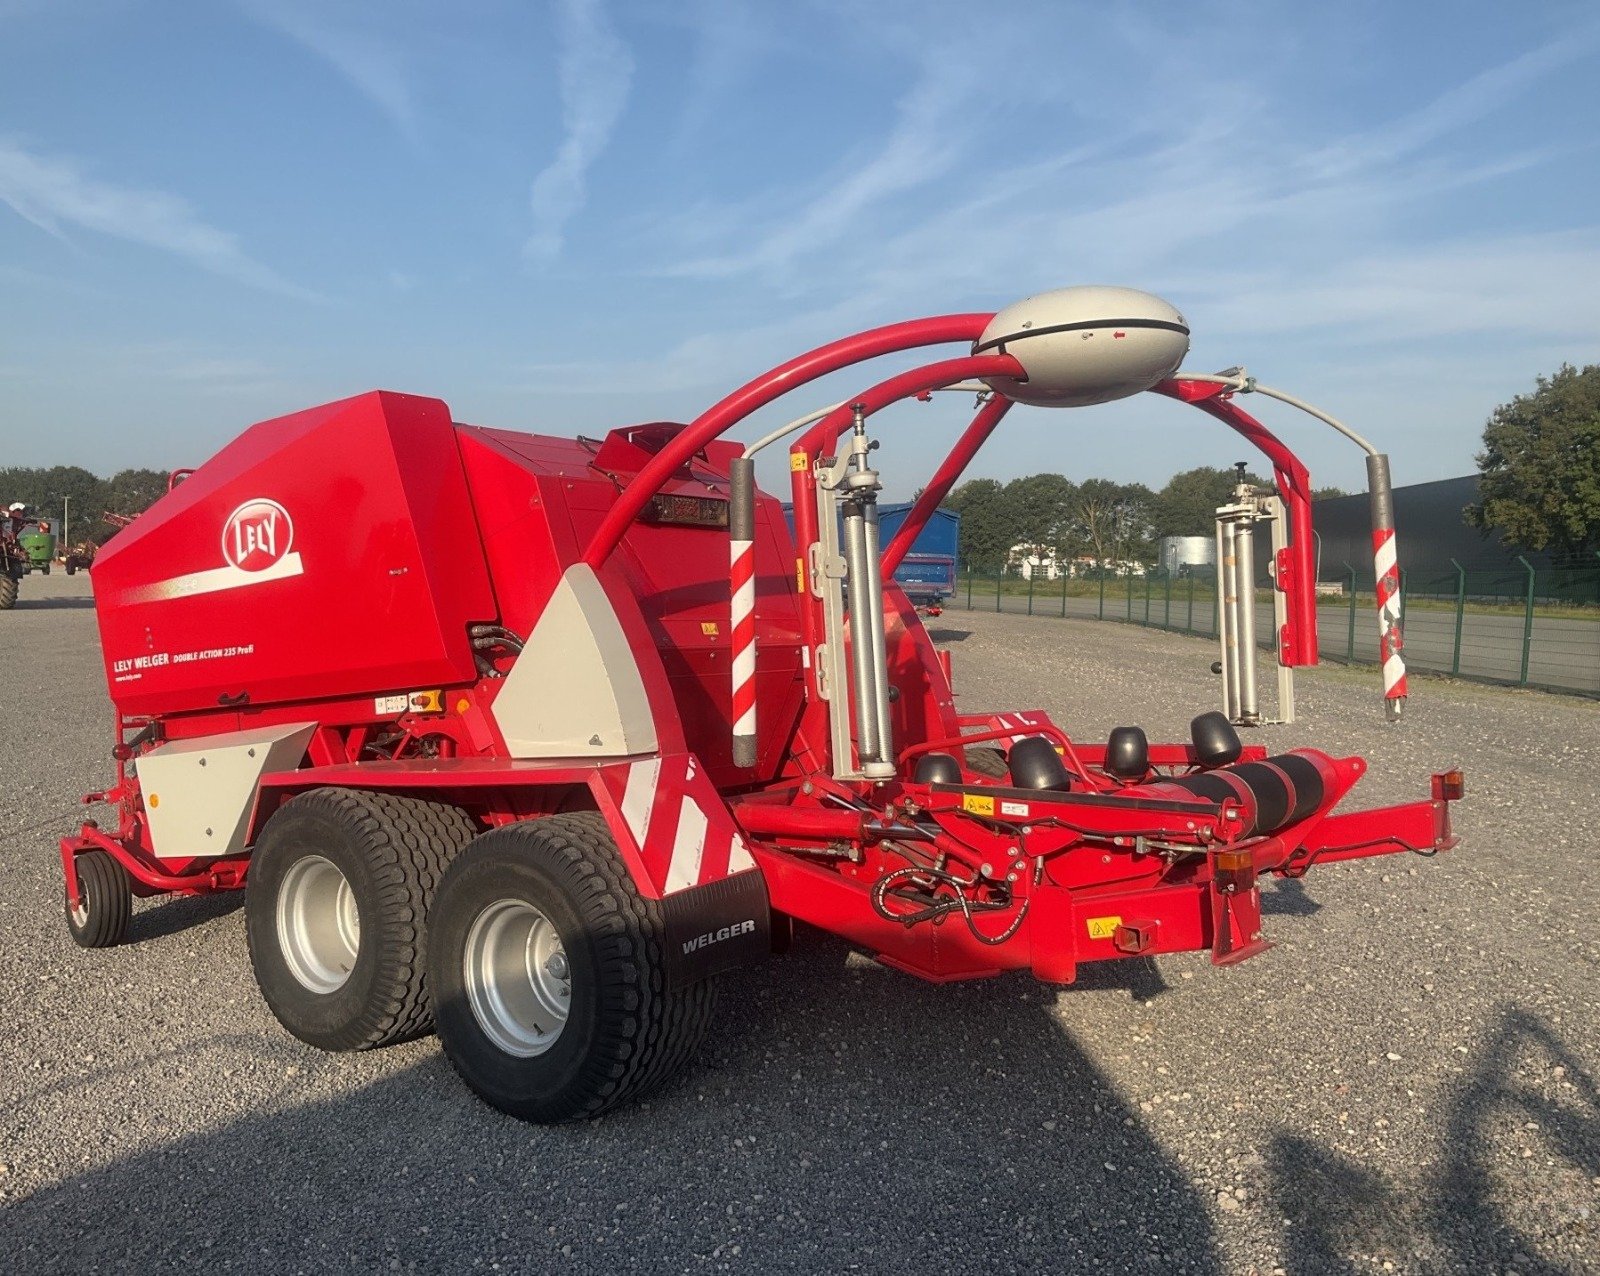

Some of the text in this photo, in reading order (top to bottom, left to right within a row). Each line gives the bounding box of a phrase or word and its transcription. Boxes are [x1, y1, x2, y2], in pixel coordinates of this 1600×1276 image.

[235, 510, 276, 565] LELY
[114, 644, 254, 673] LELY WELGER DOUBLE ACTION 235 Profi
[682, 920, 755, 955] WELGER
